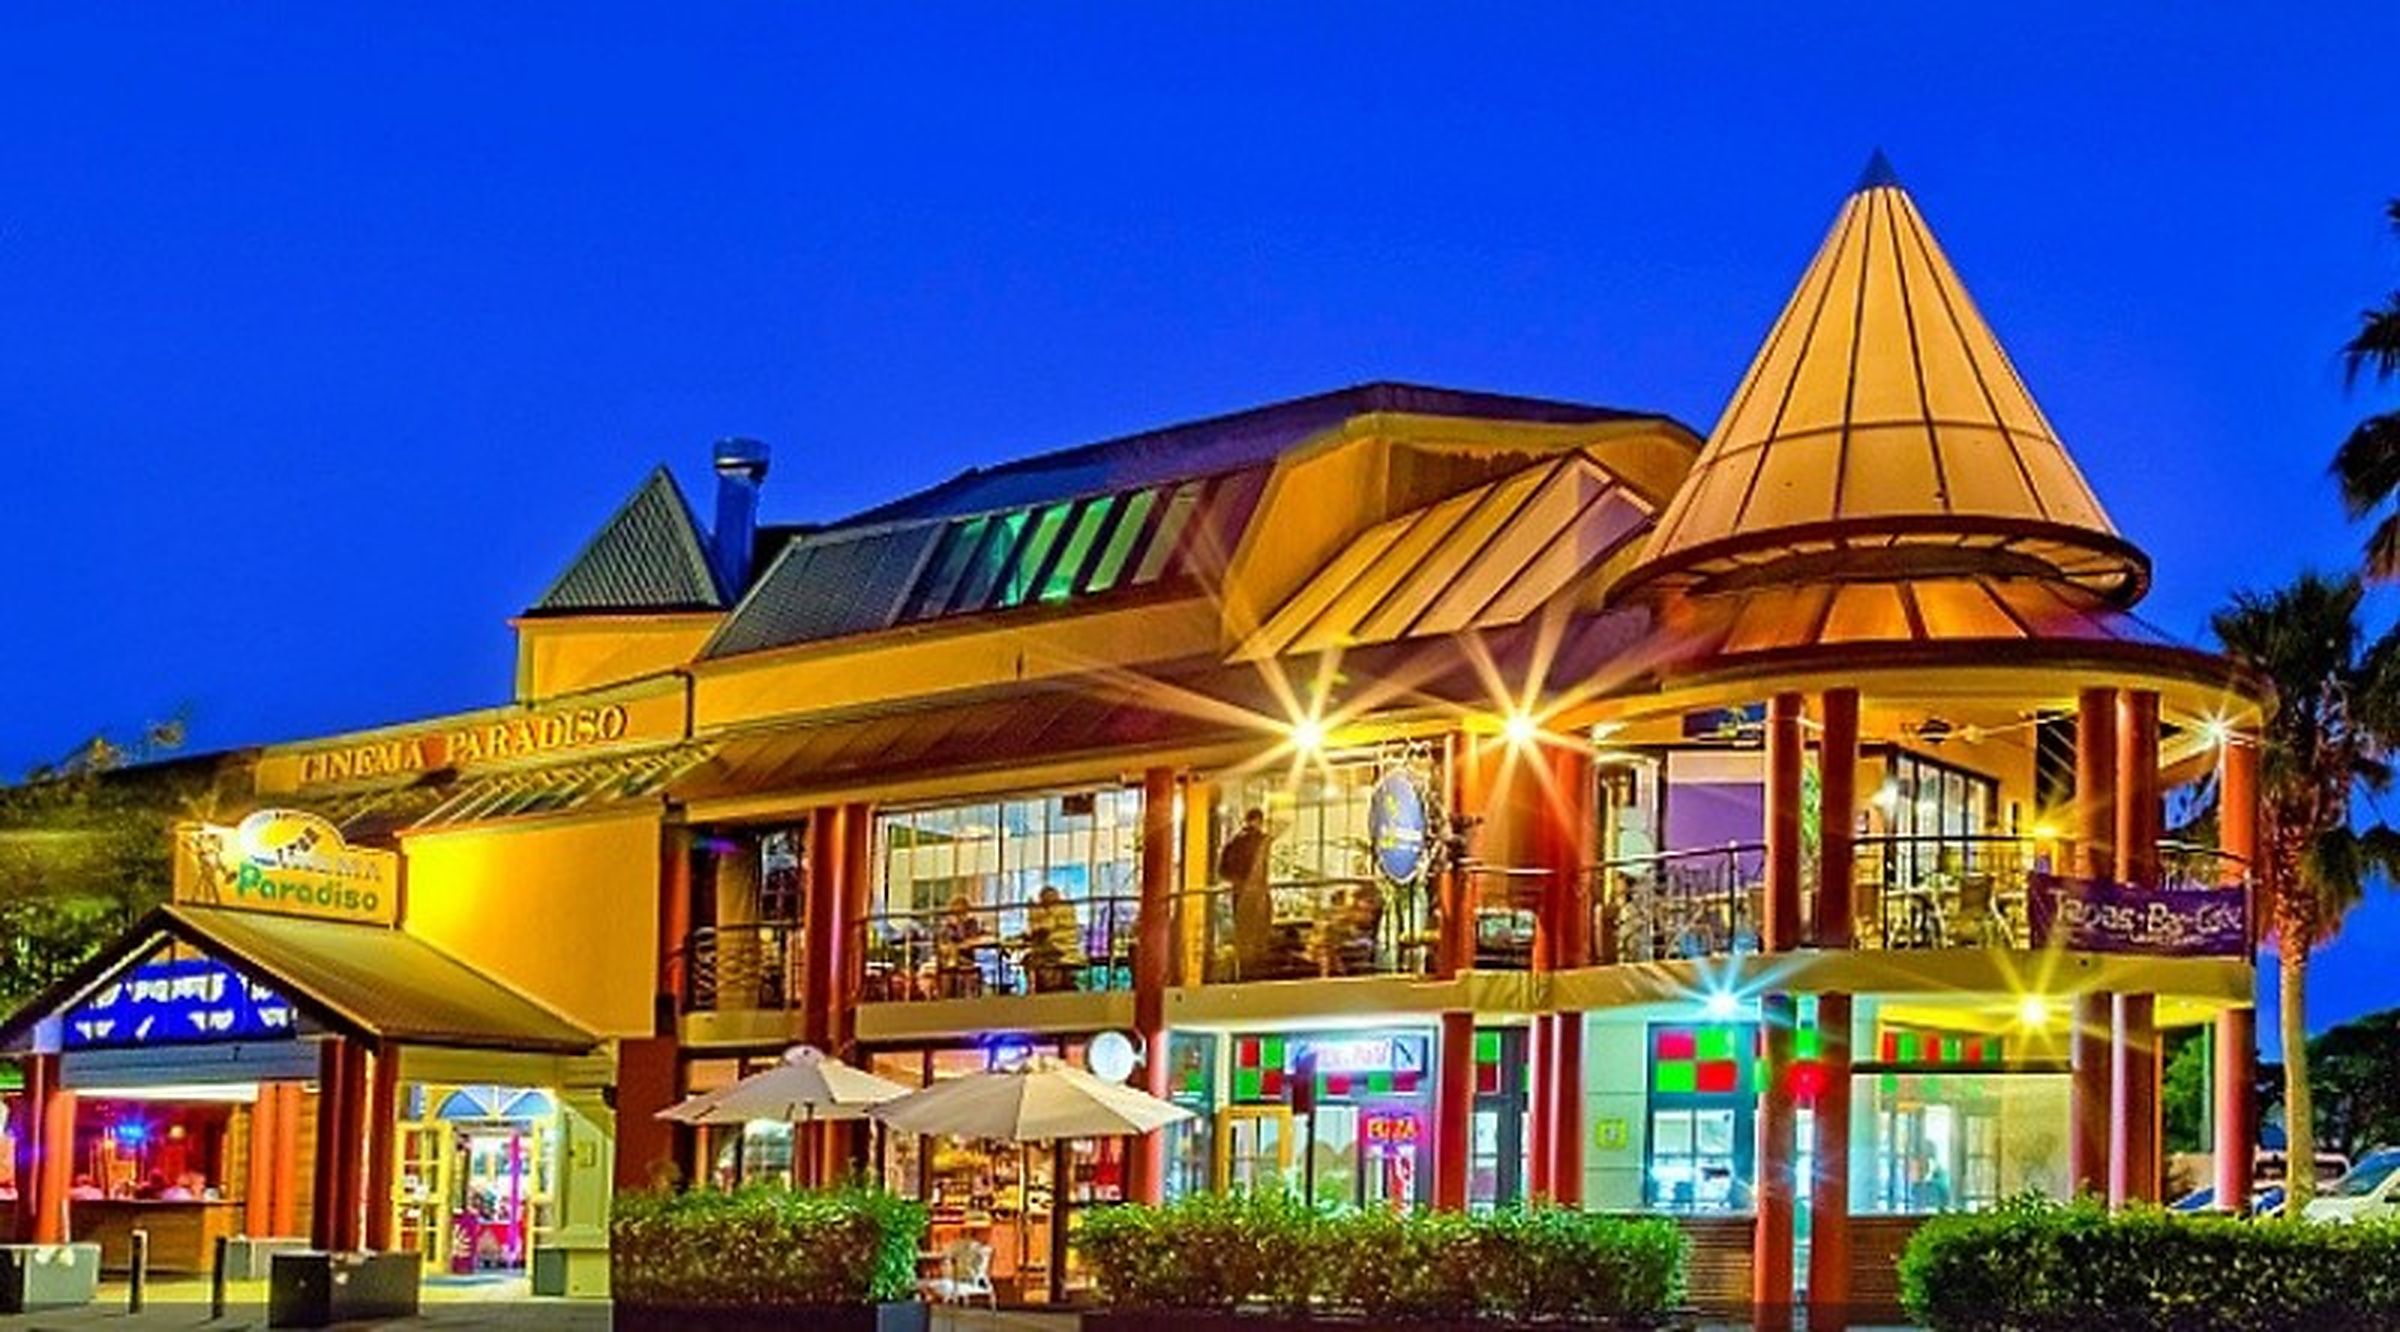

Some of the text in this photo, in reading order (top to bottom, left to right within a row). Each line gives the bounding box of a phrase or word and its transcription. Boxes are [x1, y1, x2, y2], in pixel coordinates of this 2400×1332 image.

[300, 704, 628, 783] CINEMA PARADISO
[237, 862, 379, 911] Paradiso
